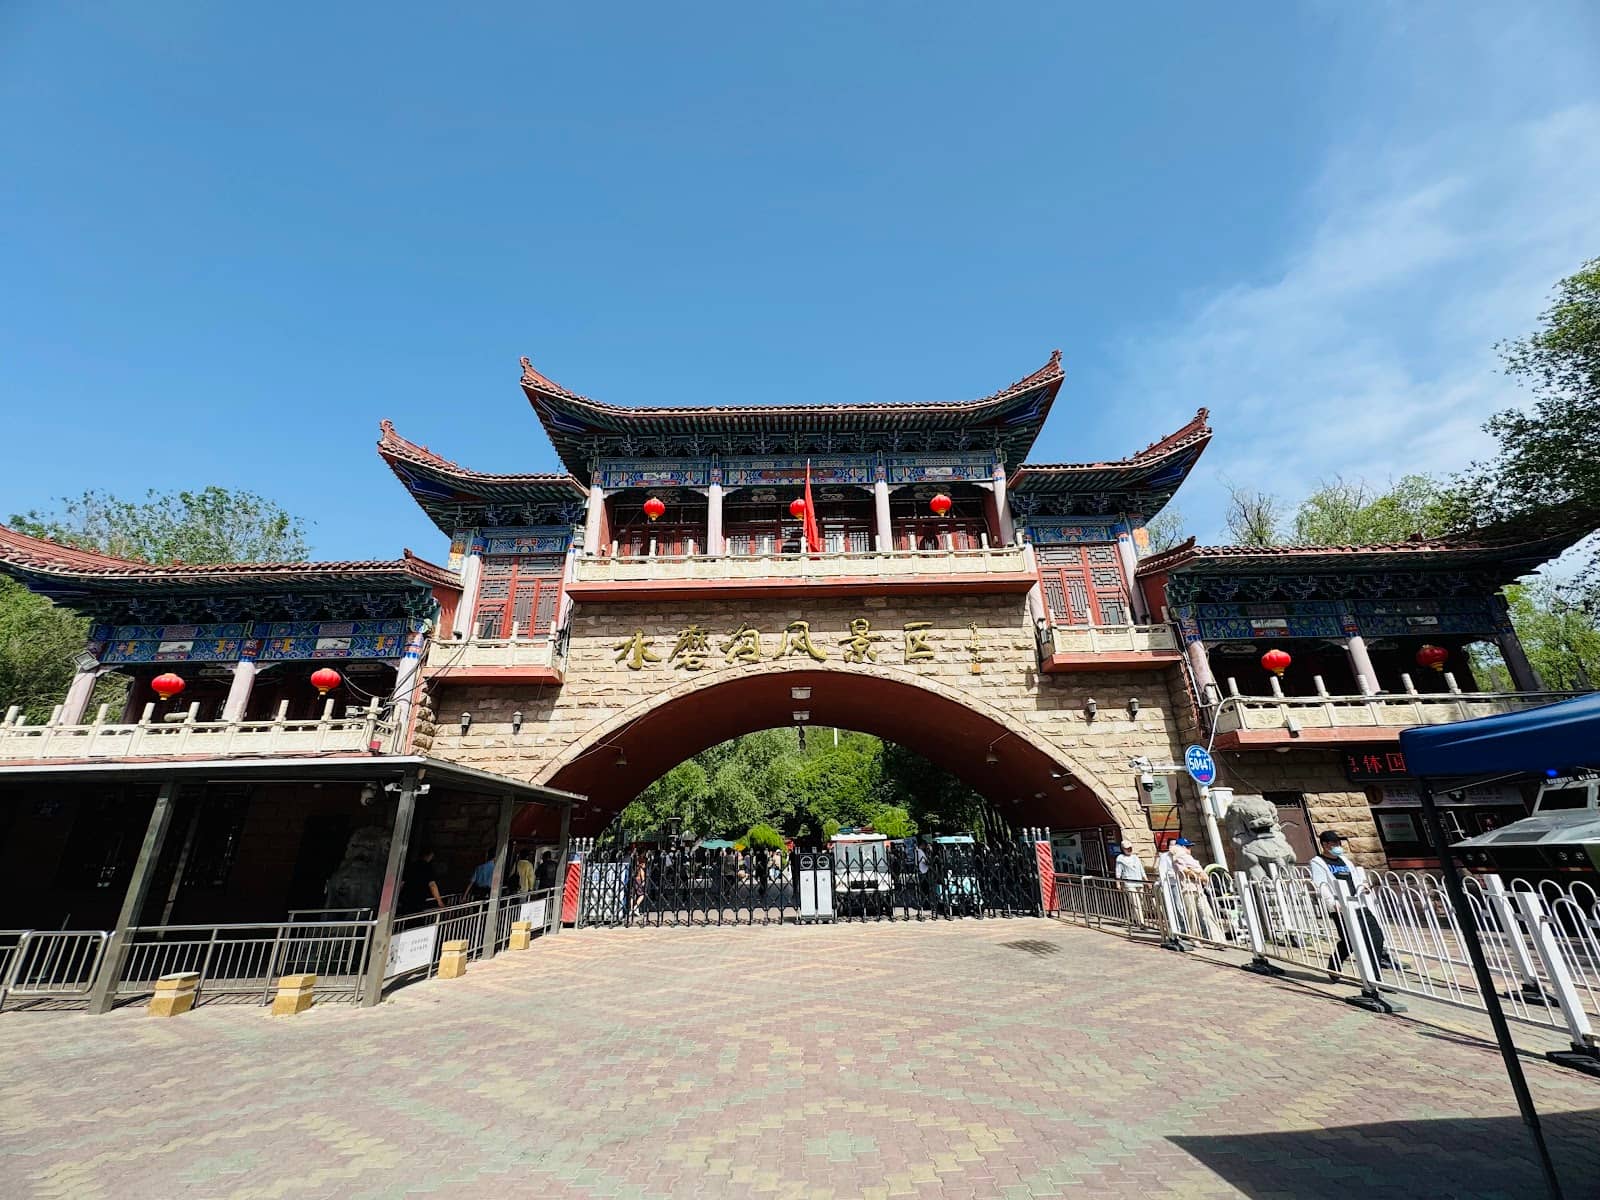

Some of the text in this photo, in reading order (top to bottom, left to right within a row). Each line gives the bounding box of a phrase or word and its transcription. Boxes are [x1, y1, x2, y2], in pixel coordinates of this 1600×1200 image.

[613, 617, 935, 671] 水磨沟风景区
